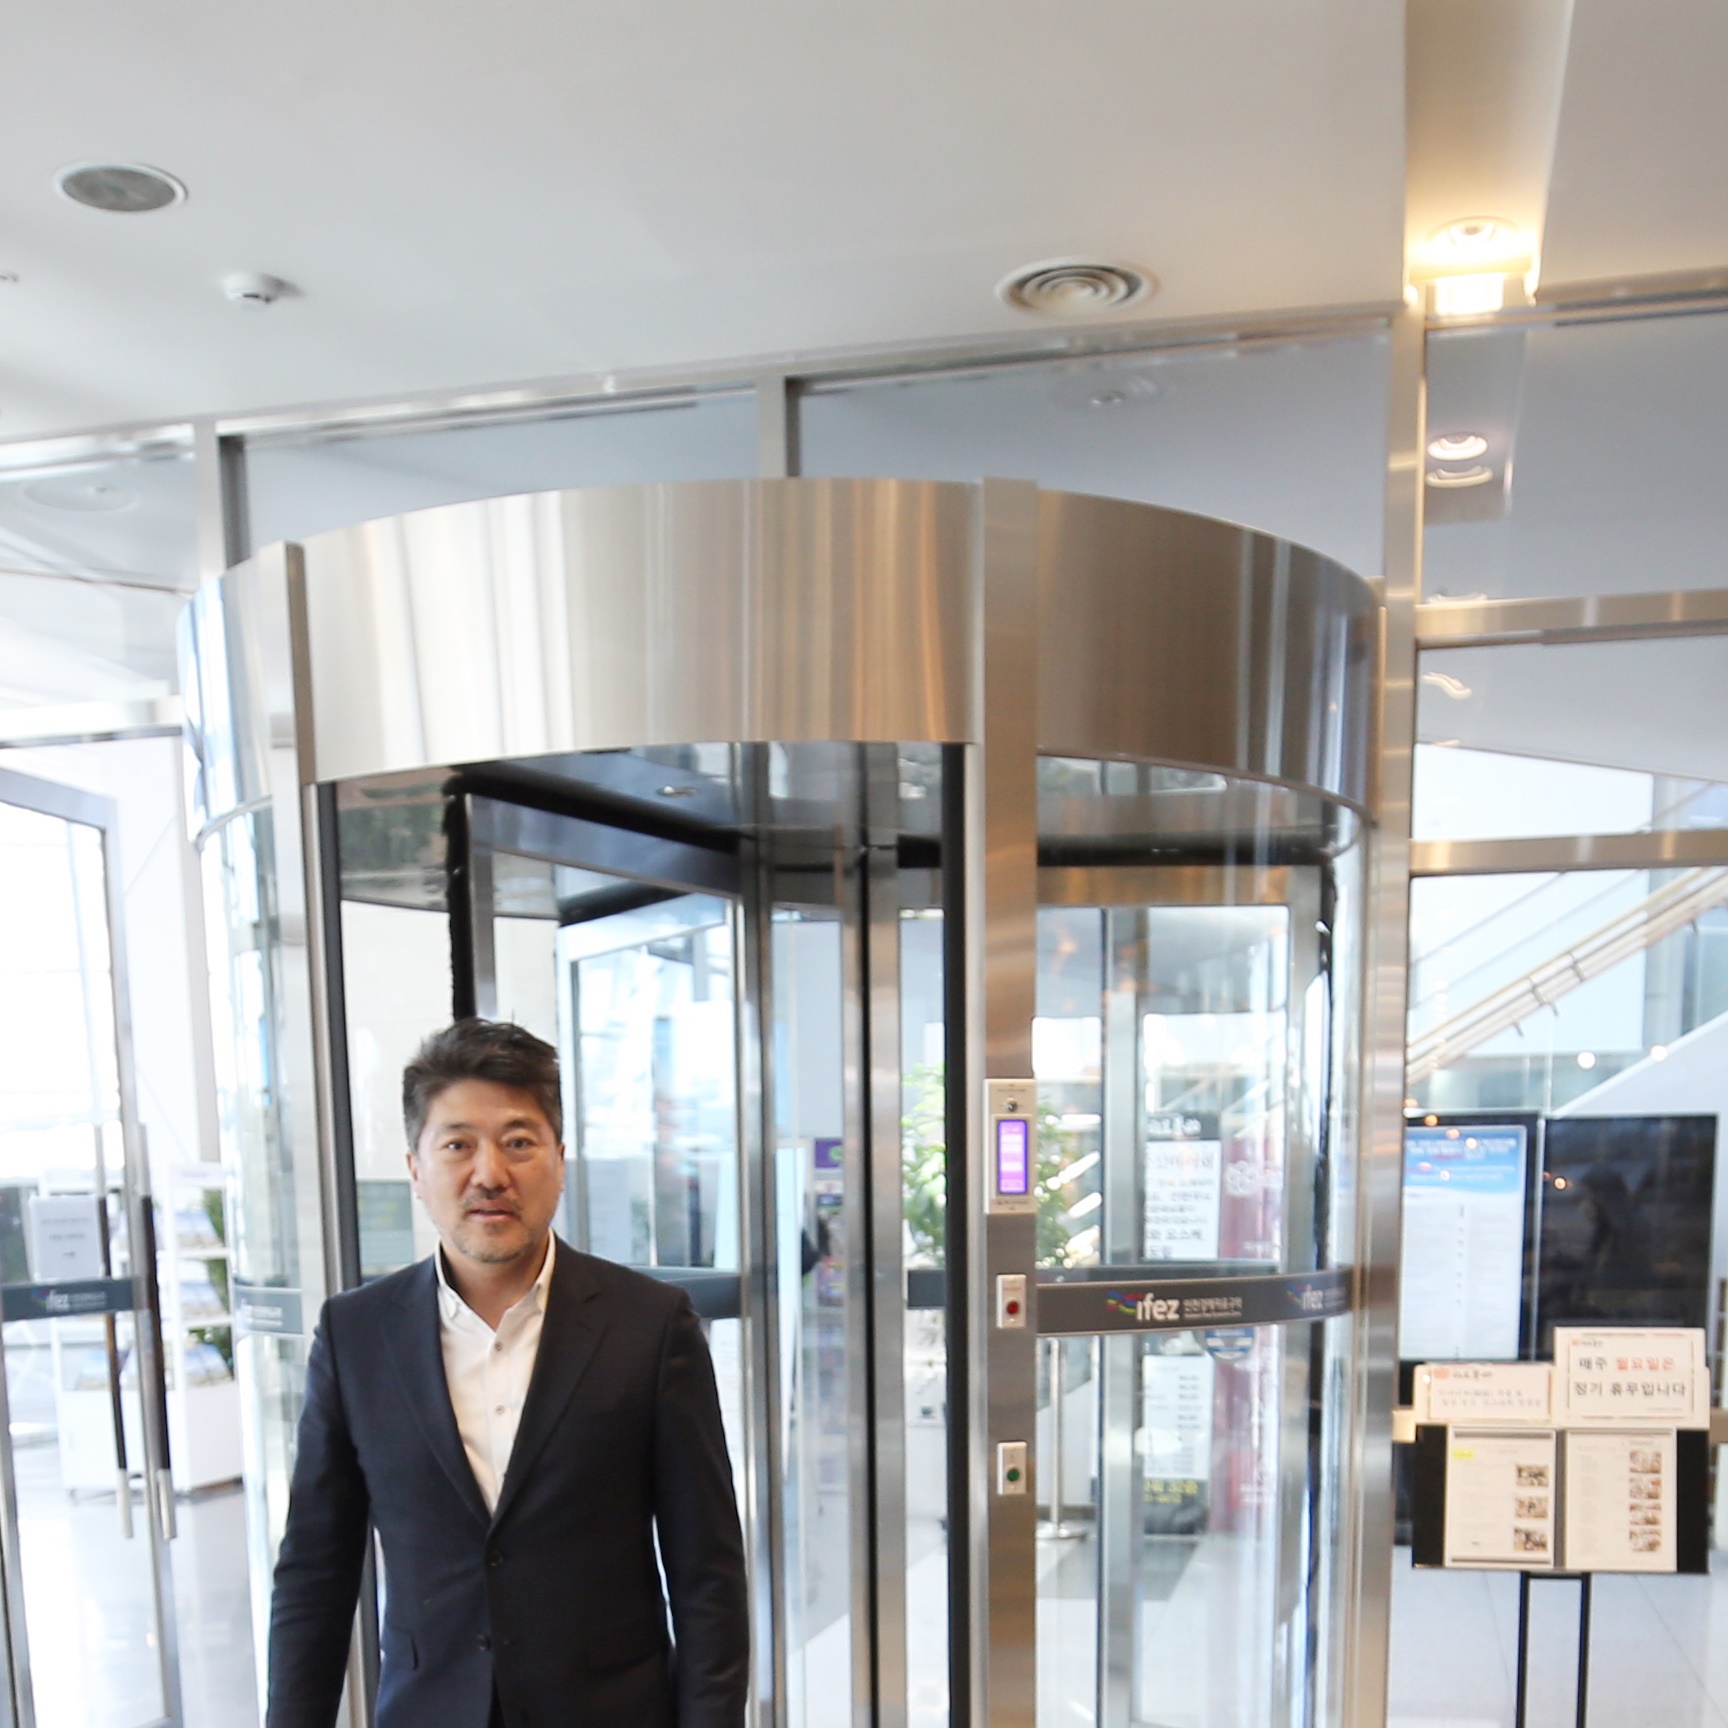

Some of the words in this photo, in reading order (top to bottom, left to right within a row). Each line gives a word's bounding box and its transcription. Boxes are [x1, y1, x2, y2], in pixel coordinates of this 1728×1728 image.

[1136, 1291, 1181, 1321] ifez
[1579, 1356, 1608, 1371] 매주
[1574, 1381, 1604, 1397] 정기
[1610, 1380, 1687, 1398] 휴무입니다
